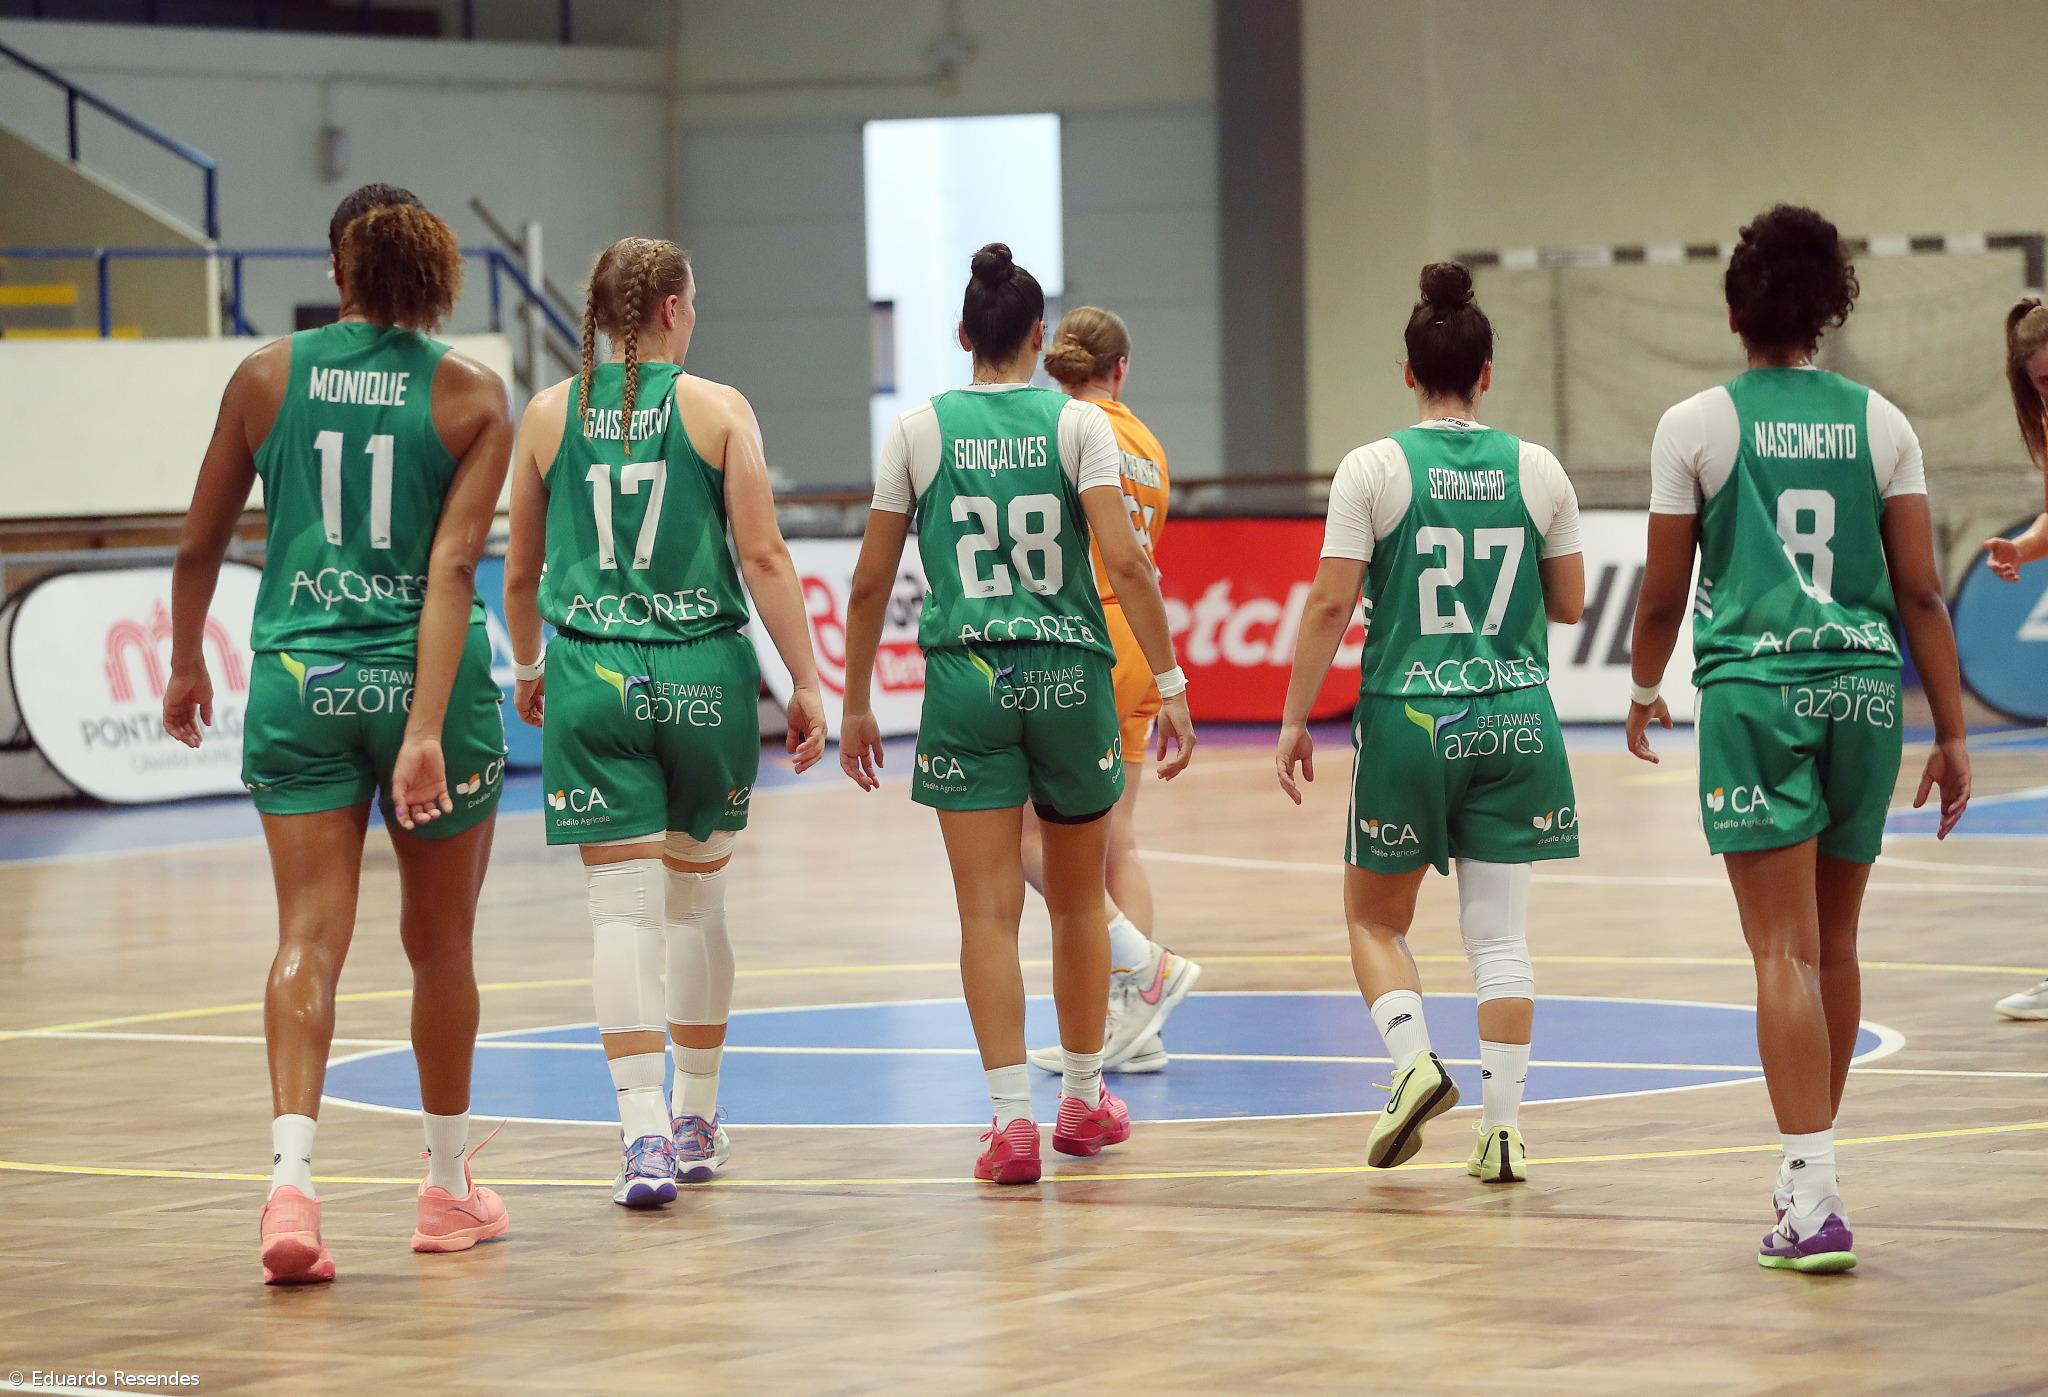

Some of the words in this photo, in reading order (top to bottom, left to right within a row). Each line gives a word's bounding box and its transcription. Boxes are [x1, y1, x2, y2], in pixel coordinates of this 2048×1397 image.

[309, 366, 410, 406] MONIQUE
[954, 436, 1047, 477] GONÇALVES
[1755, 421, 1857, 459] NASCIMENTO
[313, 430, 394, 549] 11
[1428, 467, 1506, 500] SERRALHEIRO
[585, 460, 668, 570] 17
[950, 493, 1064, 599] 28
[1776, 488, 1835, 604] 8
[1415, 526, 1525, 636] 27
[565, 588, 718, 631] AÇORES
[1401, 656, 1548, 697] AÇORES
[1476, 713, 1542, 729] GETAWAYS
[1794, 688, 1896, 729] azores
[1444, 727, 1544, 760] azores
[932, 755, 967, 780] CA
[569, 787, 609, 813] CA
[1732, 785, 1770, 813] CA
[1381, 823, 1420, 846] CA
